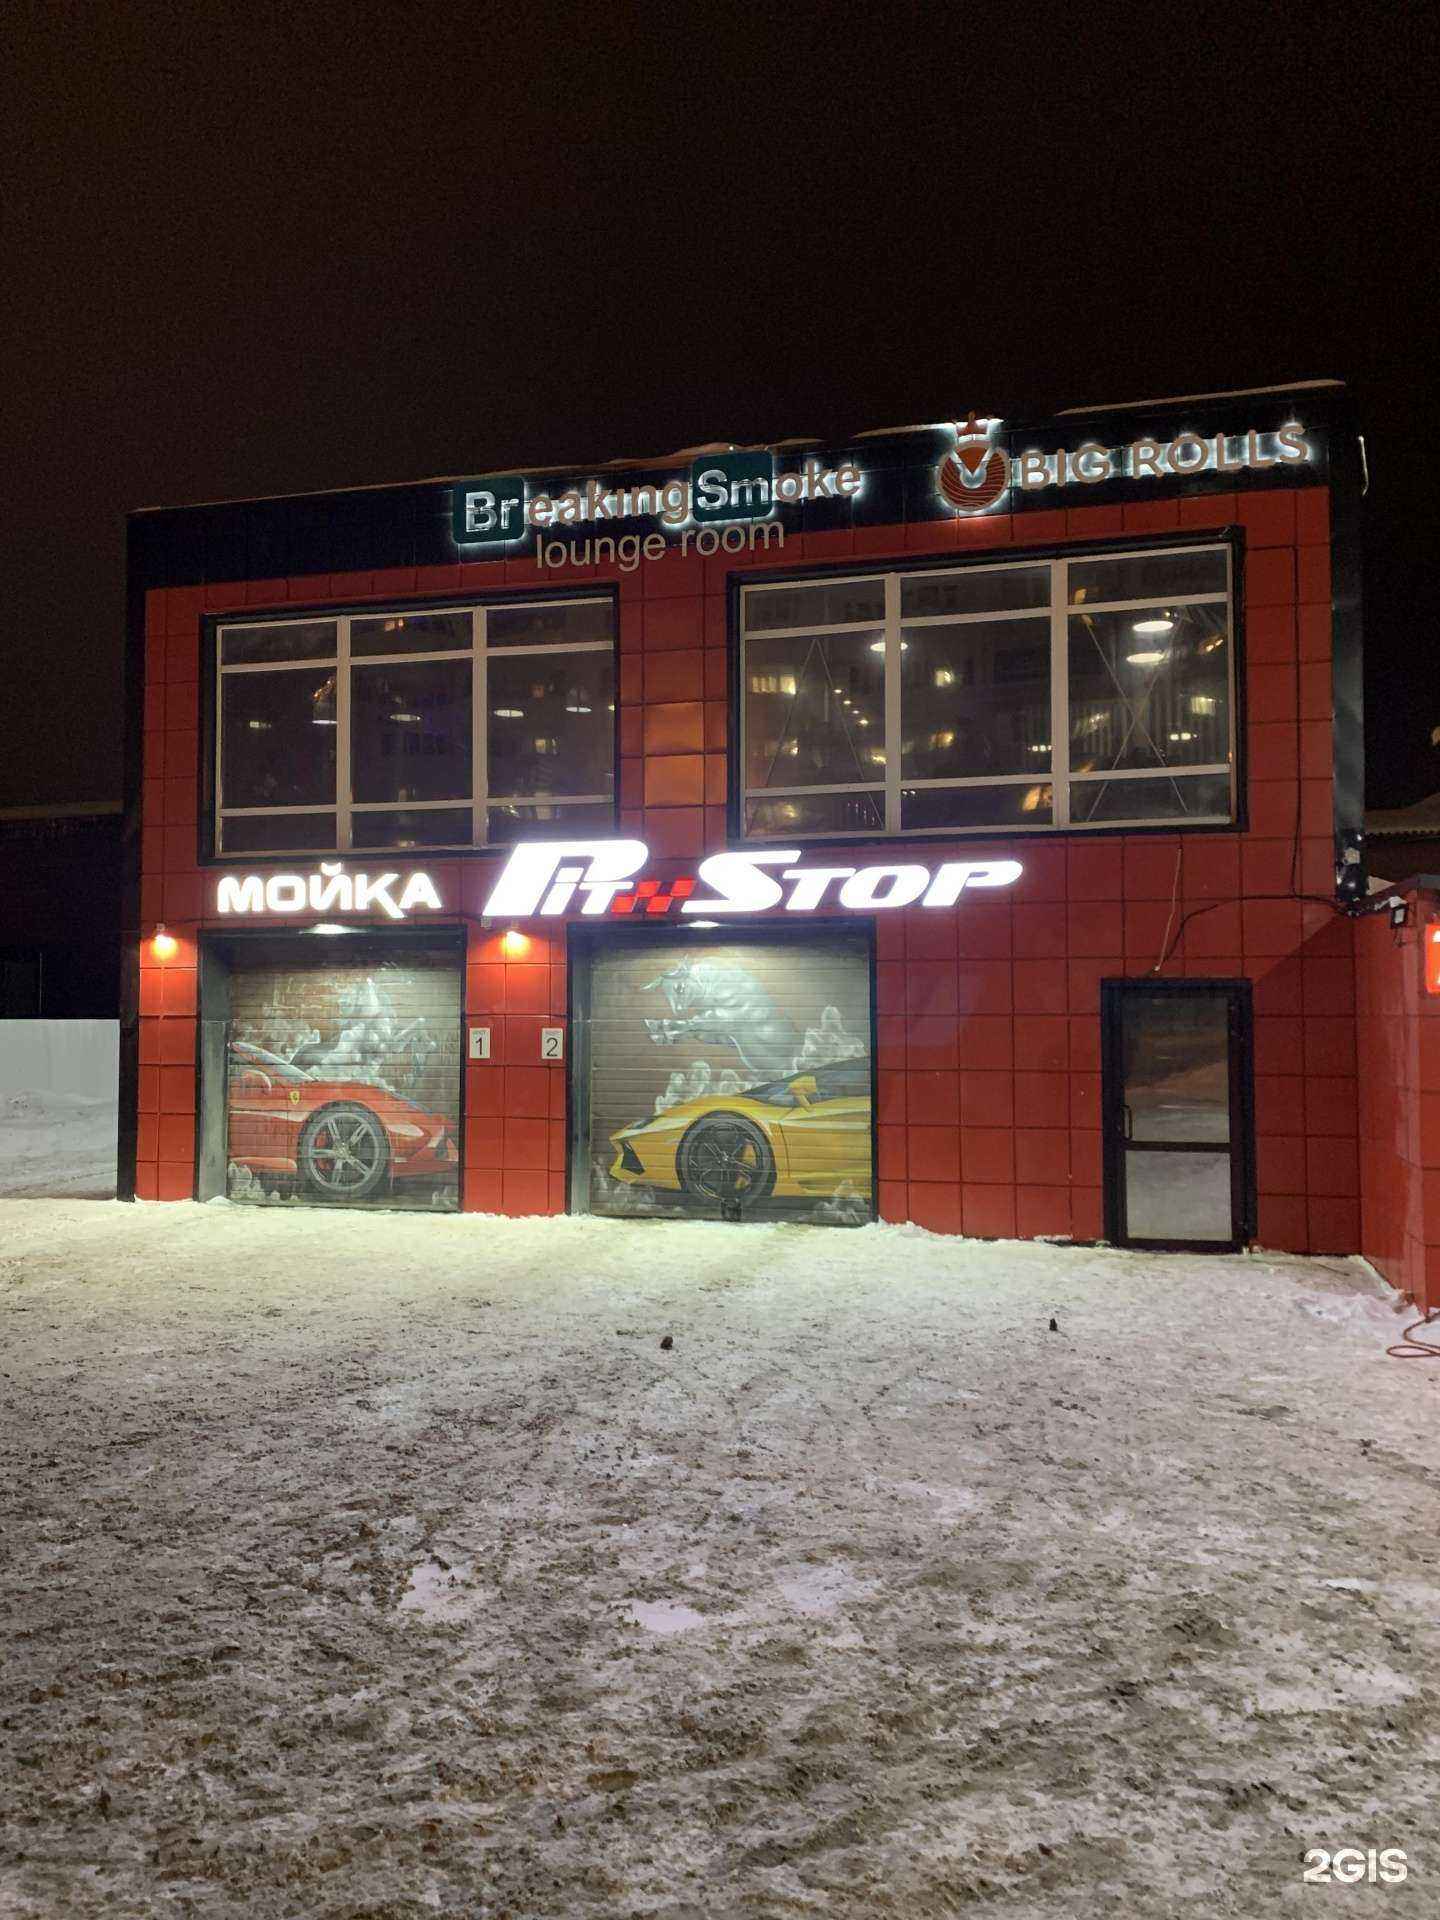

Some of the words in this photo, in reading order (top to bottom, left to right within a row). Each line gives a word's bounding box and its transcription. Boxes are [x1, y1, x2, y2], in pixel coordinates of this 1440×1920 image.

[1020, 442, 1112, 491] BIG
[1132, 423, 1309, 479] ROLLS
[536, 533, 666, 572] lounge
[681, 520, 785, 558] room
[216, 861, 443, 918] МОЙКА
[475, 1036, 483, 1056] 1
[546, 1037, 559, 1057] 2
